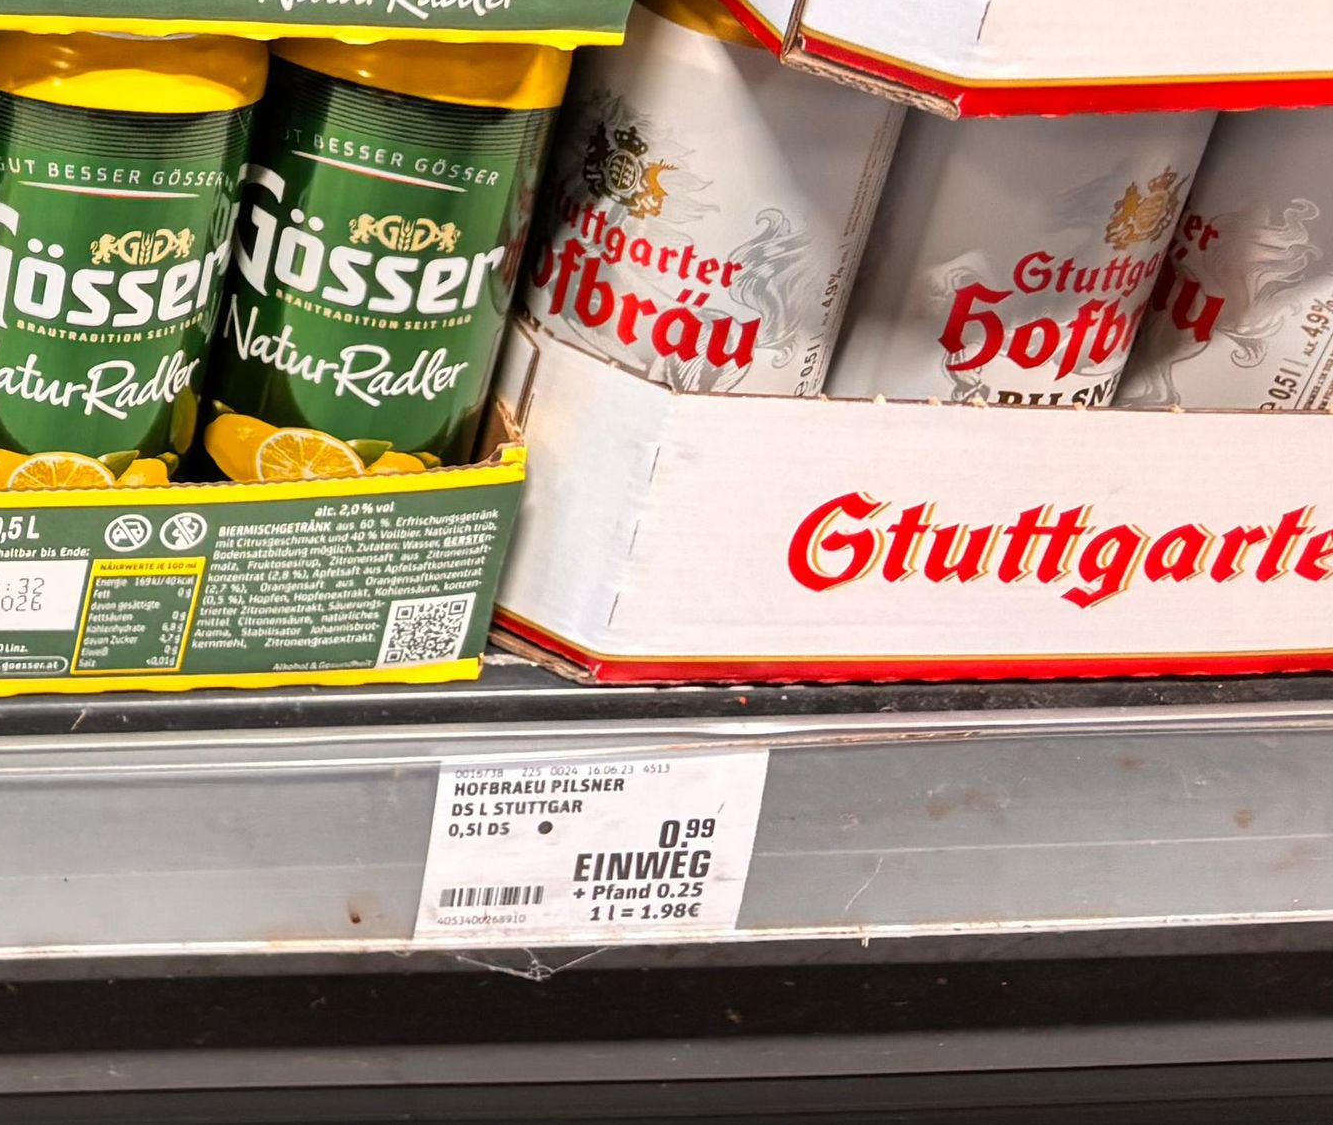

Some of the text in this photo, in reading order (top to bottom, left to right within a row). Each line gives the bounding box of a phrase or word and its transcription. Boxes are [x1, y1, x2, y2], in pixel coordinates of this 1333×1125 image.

[314, 132, 498, 187] BESSER GÖSSER
[48, 163, 141, 184] BESSER
[153, 170, 229, 187] GÖSSER
[234, 164, 506, 315] Gösser
[315, 502, 394, 517] alc. 2,0 % vol
[27, 516, 40, 539] L
[218, 522, 331, 537] BIERMISCHGETRÄNK
[40, 548, 56, 557] bis
[60, 546, 89, 557] Ende:
[787, 491, 1333, 610] Stuttgarte
[551, 767, 578, 776] 0024
[588, 765, 634, 775] 16.06.23
[455, 778, 624, 796] HOFBRAEU PILSNER
[452, 800, 582, 816] DS L STUTTGAR
[487, 822, 510, 836] DS
[659, 818, 715, 848] 0.99
[574, 850, 711, 882] EINWEG
[573, 883, 704, 900] + Pfand 0.25
[591, 907, 599, 921] 1
[622, 909, 633, 918] =
[642, 903, 701, 919] 1.98€
